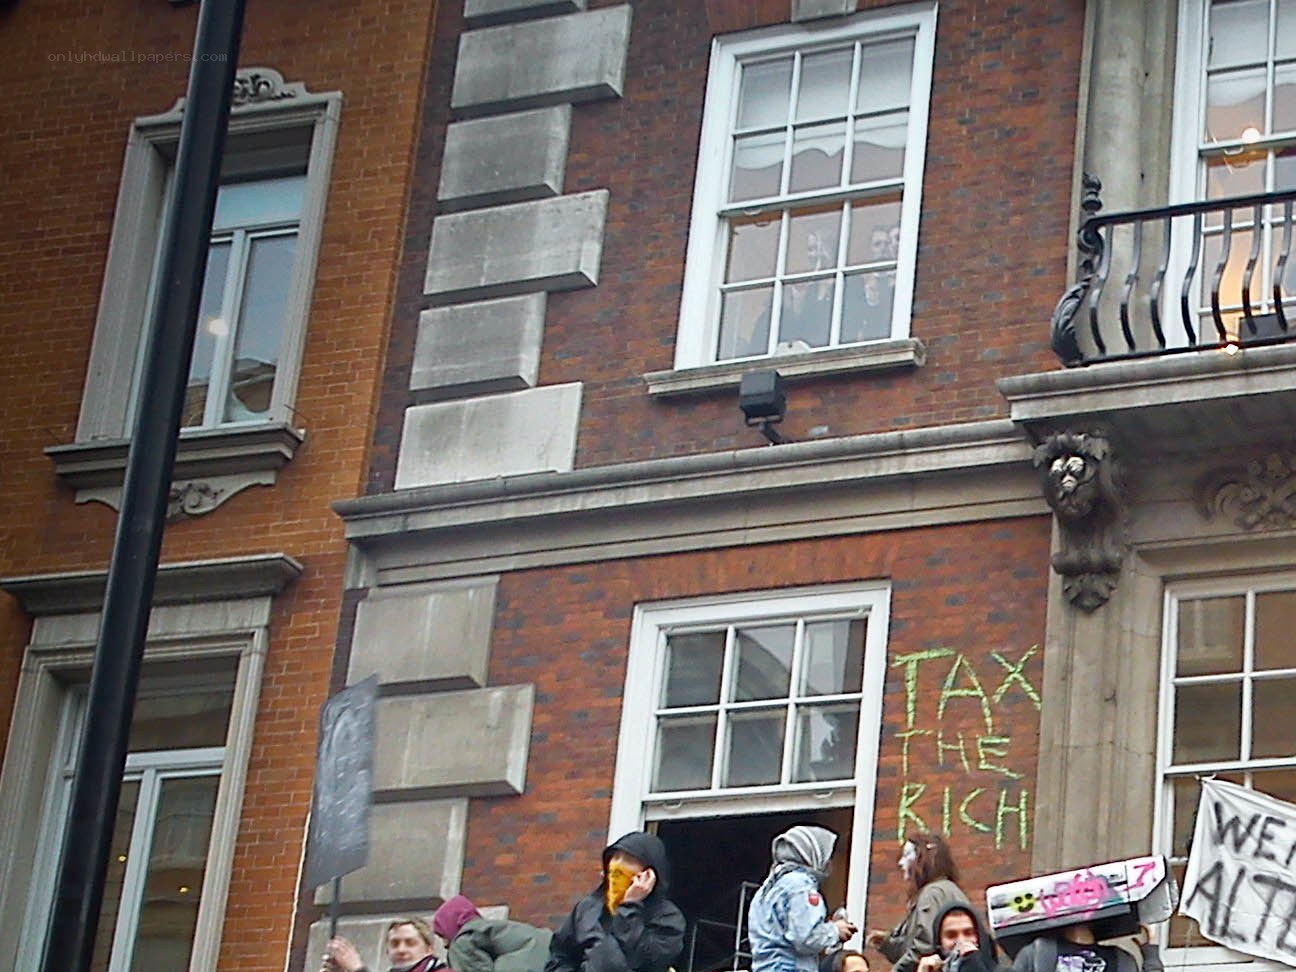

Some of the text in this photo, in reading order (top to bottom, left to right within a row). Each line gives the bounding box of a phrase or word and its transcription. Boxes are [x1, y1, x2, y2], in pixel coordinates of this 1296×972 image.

[891, 644, 1042, 735] TAX
[894, 728, 1024, 780] THE
[898, 782, 1028, 849] RICH
[1214, 801, 1286, 861] WE
